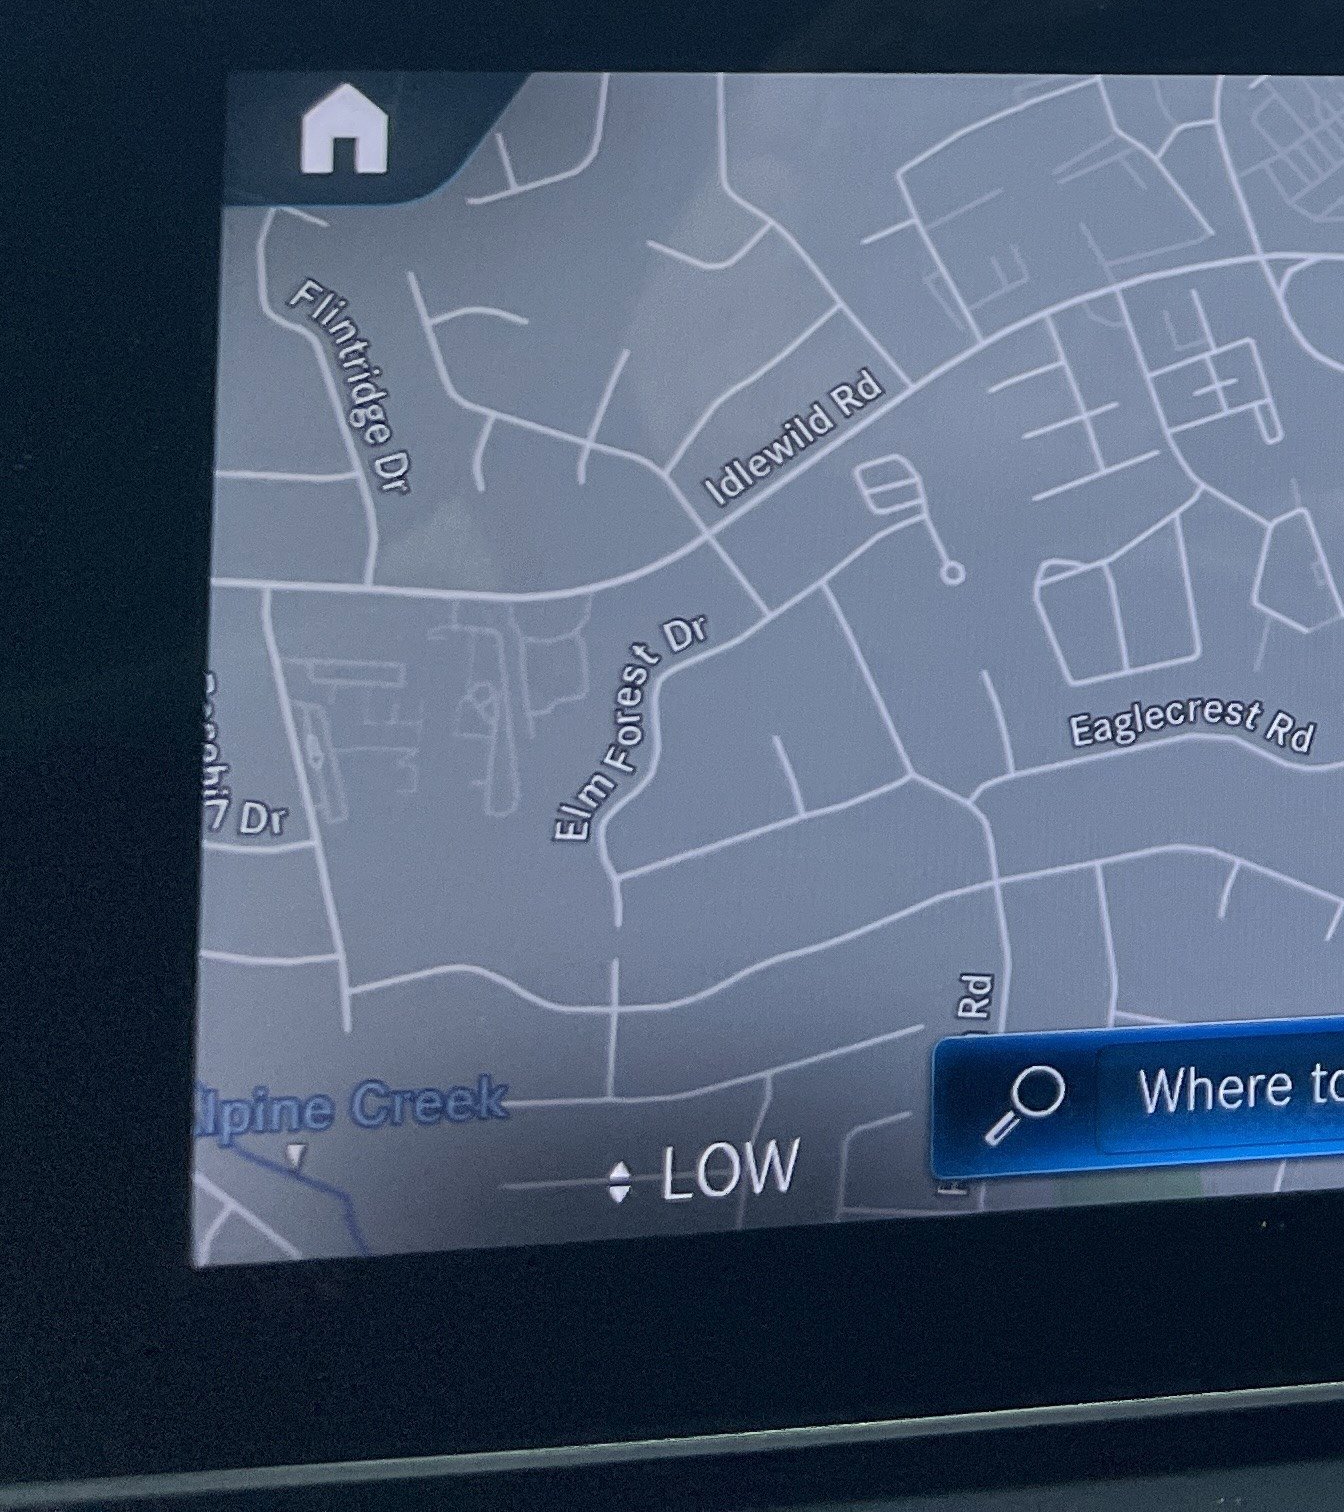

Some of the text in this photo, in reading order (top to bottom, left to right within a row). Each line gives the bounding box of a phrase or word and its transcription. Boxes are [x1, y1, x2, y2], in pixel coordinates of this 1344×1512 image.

[287, 278, 411, 493] Flintridge Dr
[703, 368, 883, 506] Idlewild Rd
[554, 615, 707, 842] Elm Forest Dr
[1069, 698, 1316, 755] Eaglecrest Rd
[238, 800, 289, 835] Dr
[957, 973, 994, 1019] Rd
[194, 1072, 510, 1149] lpine Creek
[1138, 1064, 1294, 1115] Where
[662, 1136, 802, 1201] LOW
